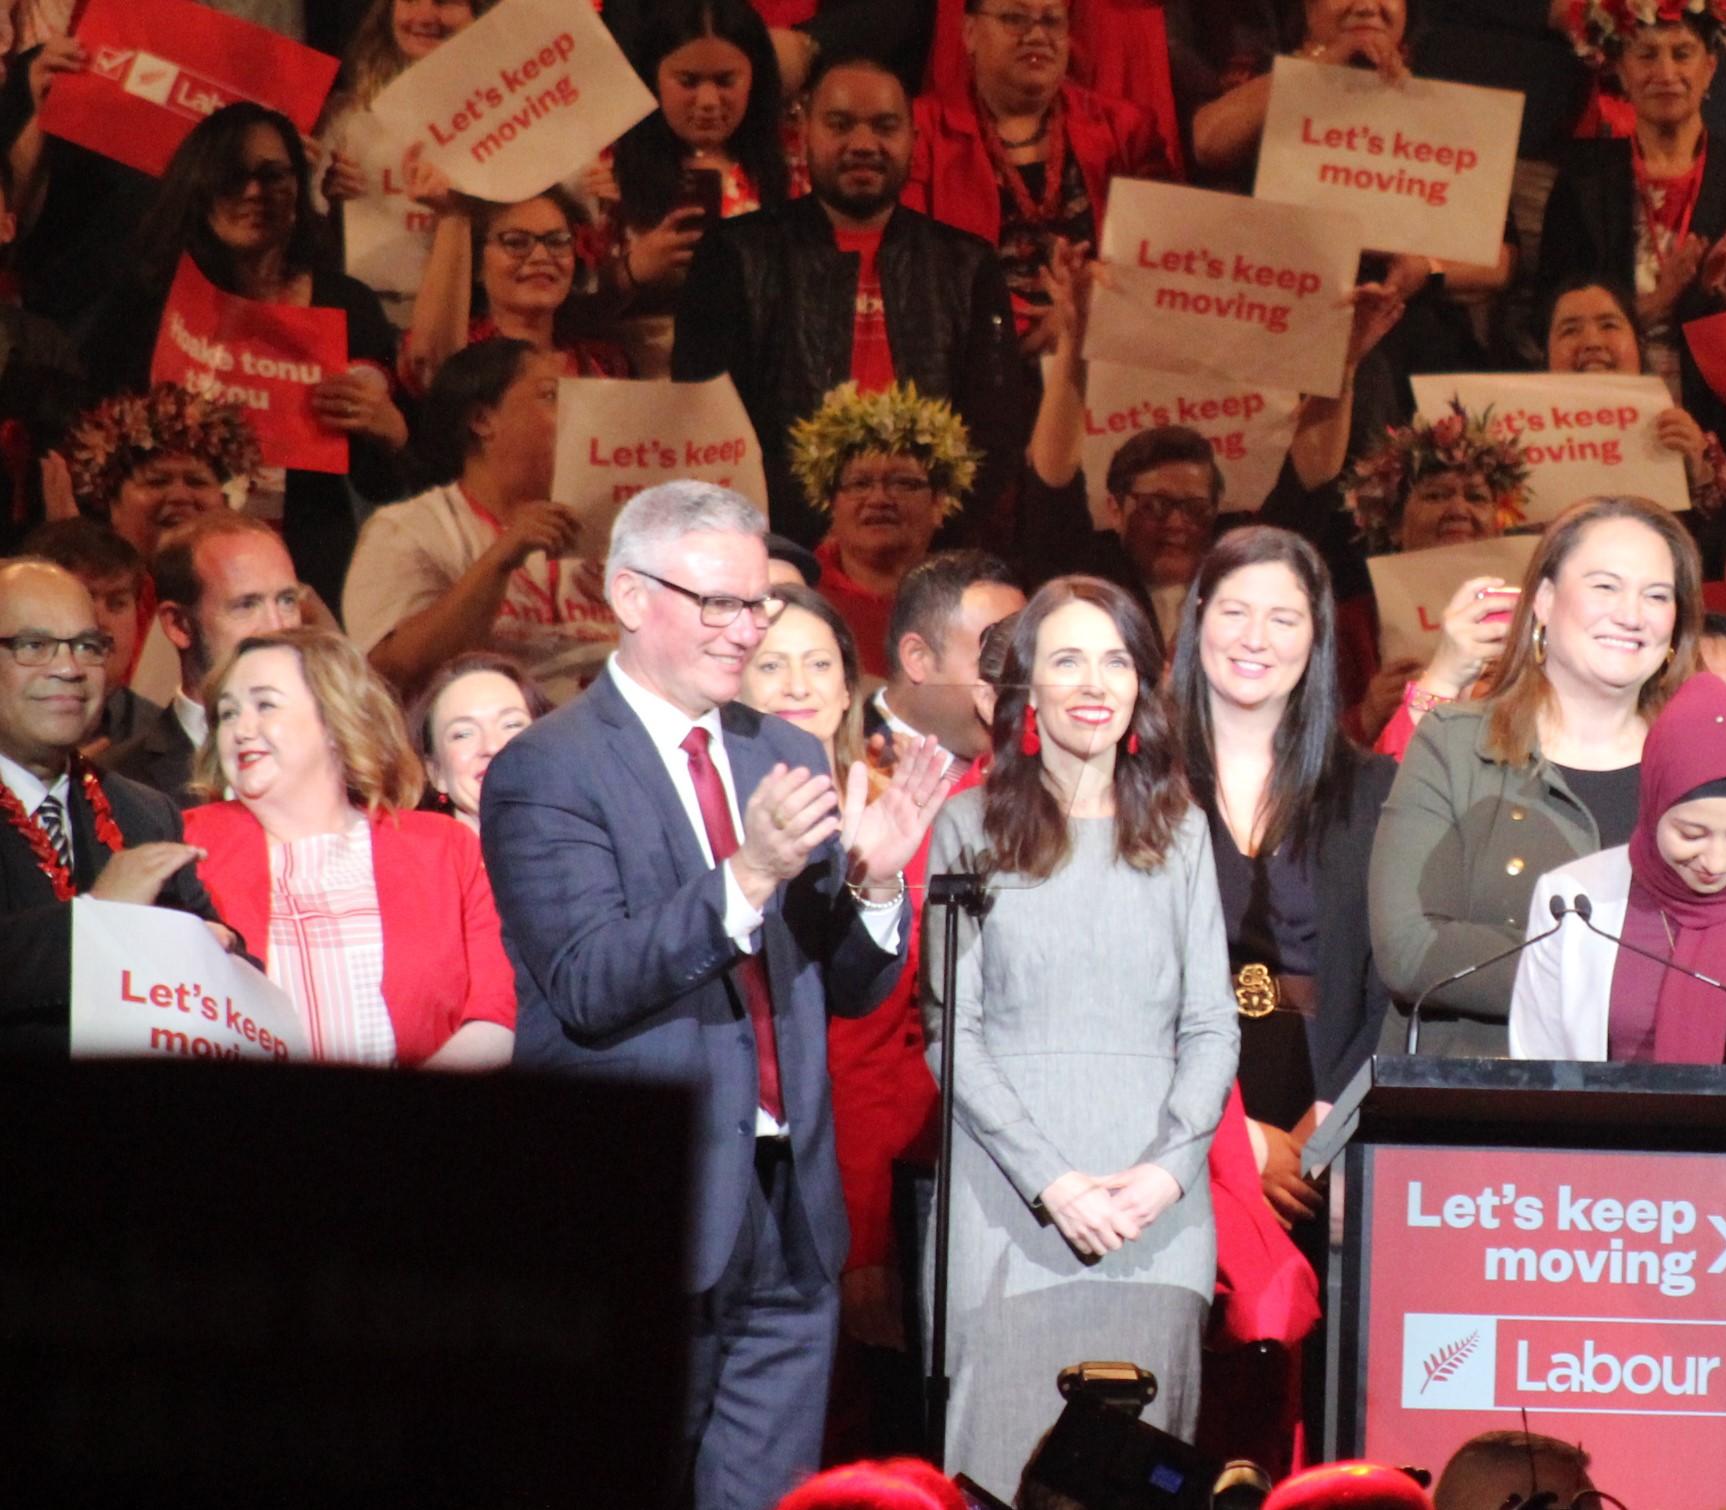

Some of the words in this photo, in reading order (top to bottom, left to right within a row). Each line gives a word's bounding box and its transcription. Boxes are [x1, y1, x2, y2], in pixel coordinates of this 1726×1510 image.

[429, 85, 502, 147] Let's
[503, 31, 577, 98] keep
[469, 72, 580, 165] moving
[1302, 118, 1385, 157] Let's
[1391, 133, 1479, 173] keep
[1318, 164, 1449, 206] moving
[1138, 240, 1224, 278] Let's
[1231, 258, 1321, 296] keep
[1155, 286, 1290, 333] moving
[241, 351, 322, 384] tonu
[1085, 401, 1170, 436] Let's
[1177, 393, 1264, 422] keep
[1551, 406, 1639, 431] keep
[590, 437, 677, 468] Let's
[686, 437, 746, 467] keep
[1526, 437, 1623, 466] oving
[121, 970, 219, 1022] Let's
[226, 997, 289, 1063] keep
[1407, 1181, 1544, 1231] Let's
[1558, 1185, 1697, 1244] keep
[1484, 1239, 1697, 1296] moving
[1516, 1339, 1721, 1396] Labour
